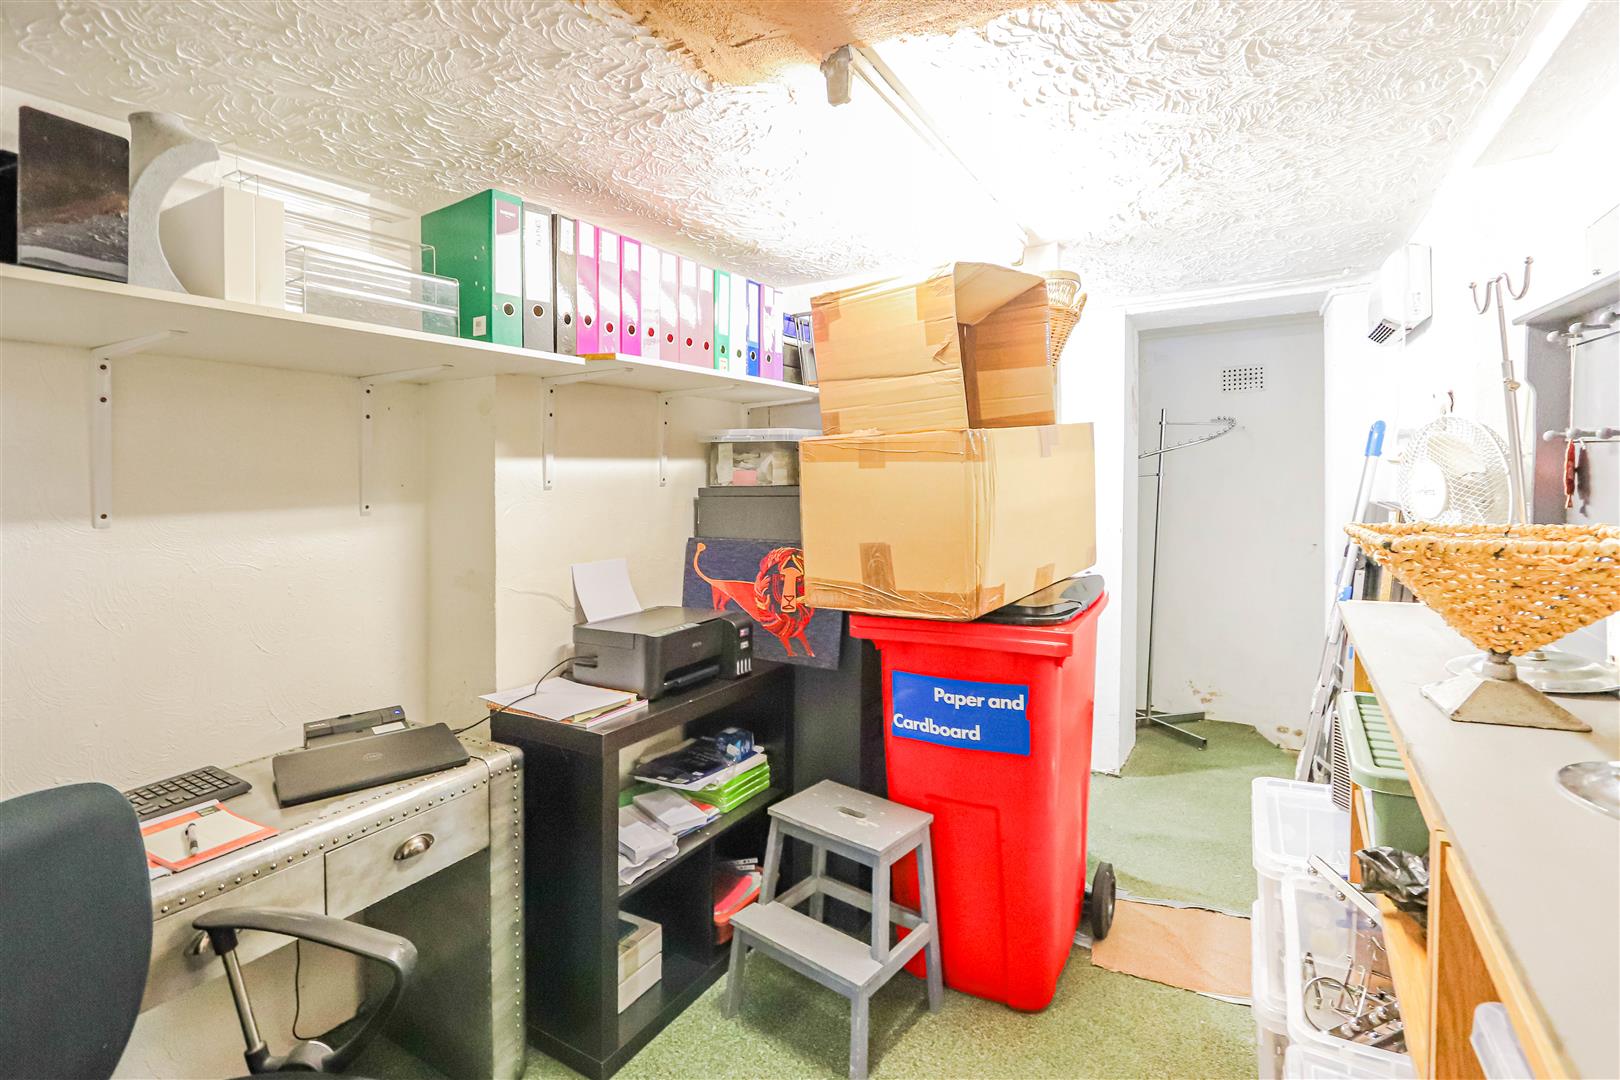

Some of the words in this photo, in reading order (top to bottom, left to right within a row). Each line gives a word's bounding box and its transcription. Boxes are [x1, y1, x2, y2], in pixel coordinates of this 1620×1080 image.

[933, 687, 985, 709] Paper
[987, 694, 1025, 711] and
[893, 713, 981, 741] Cardboard
